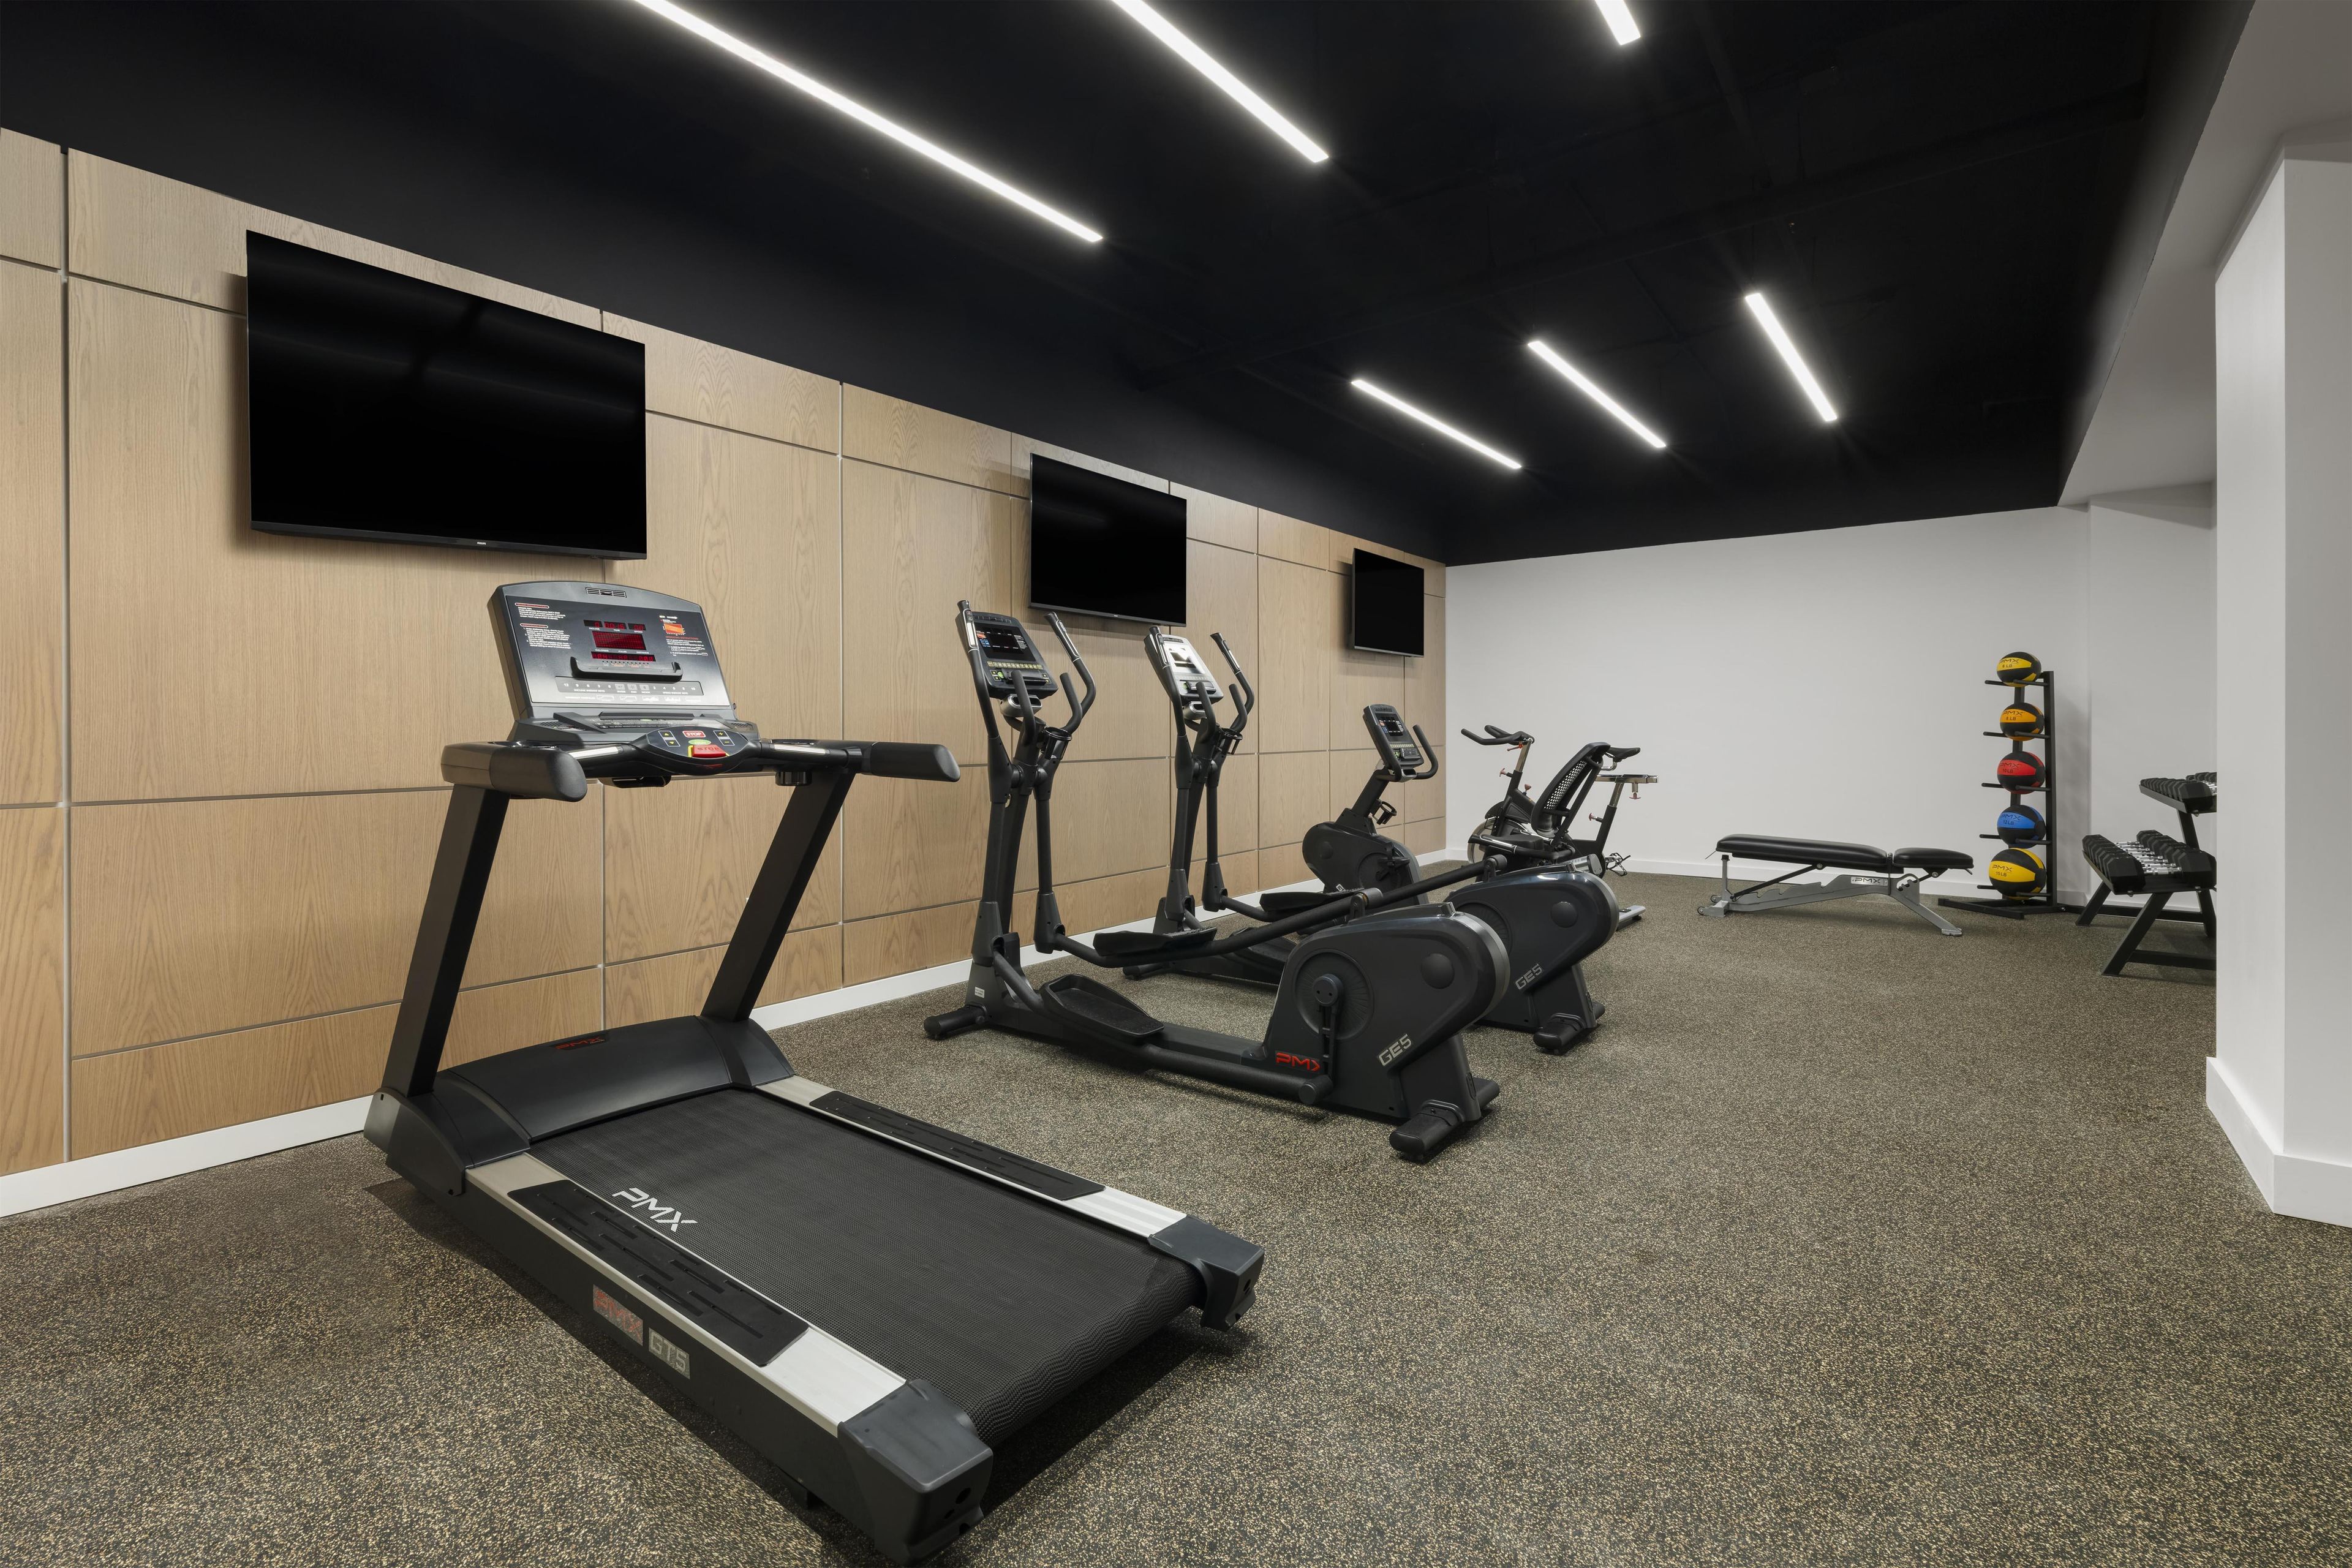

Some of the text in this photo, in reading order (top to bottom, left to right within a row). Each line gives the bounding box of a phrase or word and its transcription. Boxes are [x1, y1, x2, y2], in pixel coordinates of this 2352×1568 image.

[1515, 963, 1542, 990] GE5
[1378, 1034, 1412, 1066] GE5
[612, 1188, 698, 1232] PMX
[594, 1289, 643, 1345] PMX
